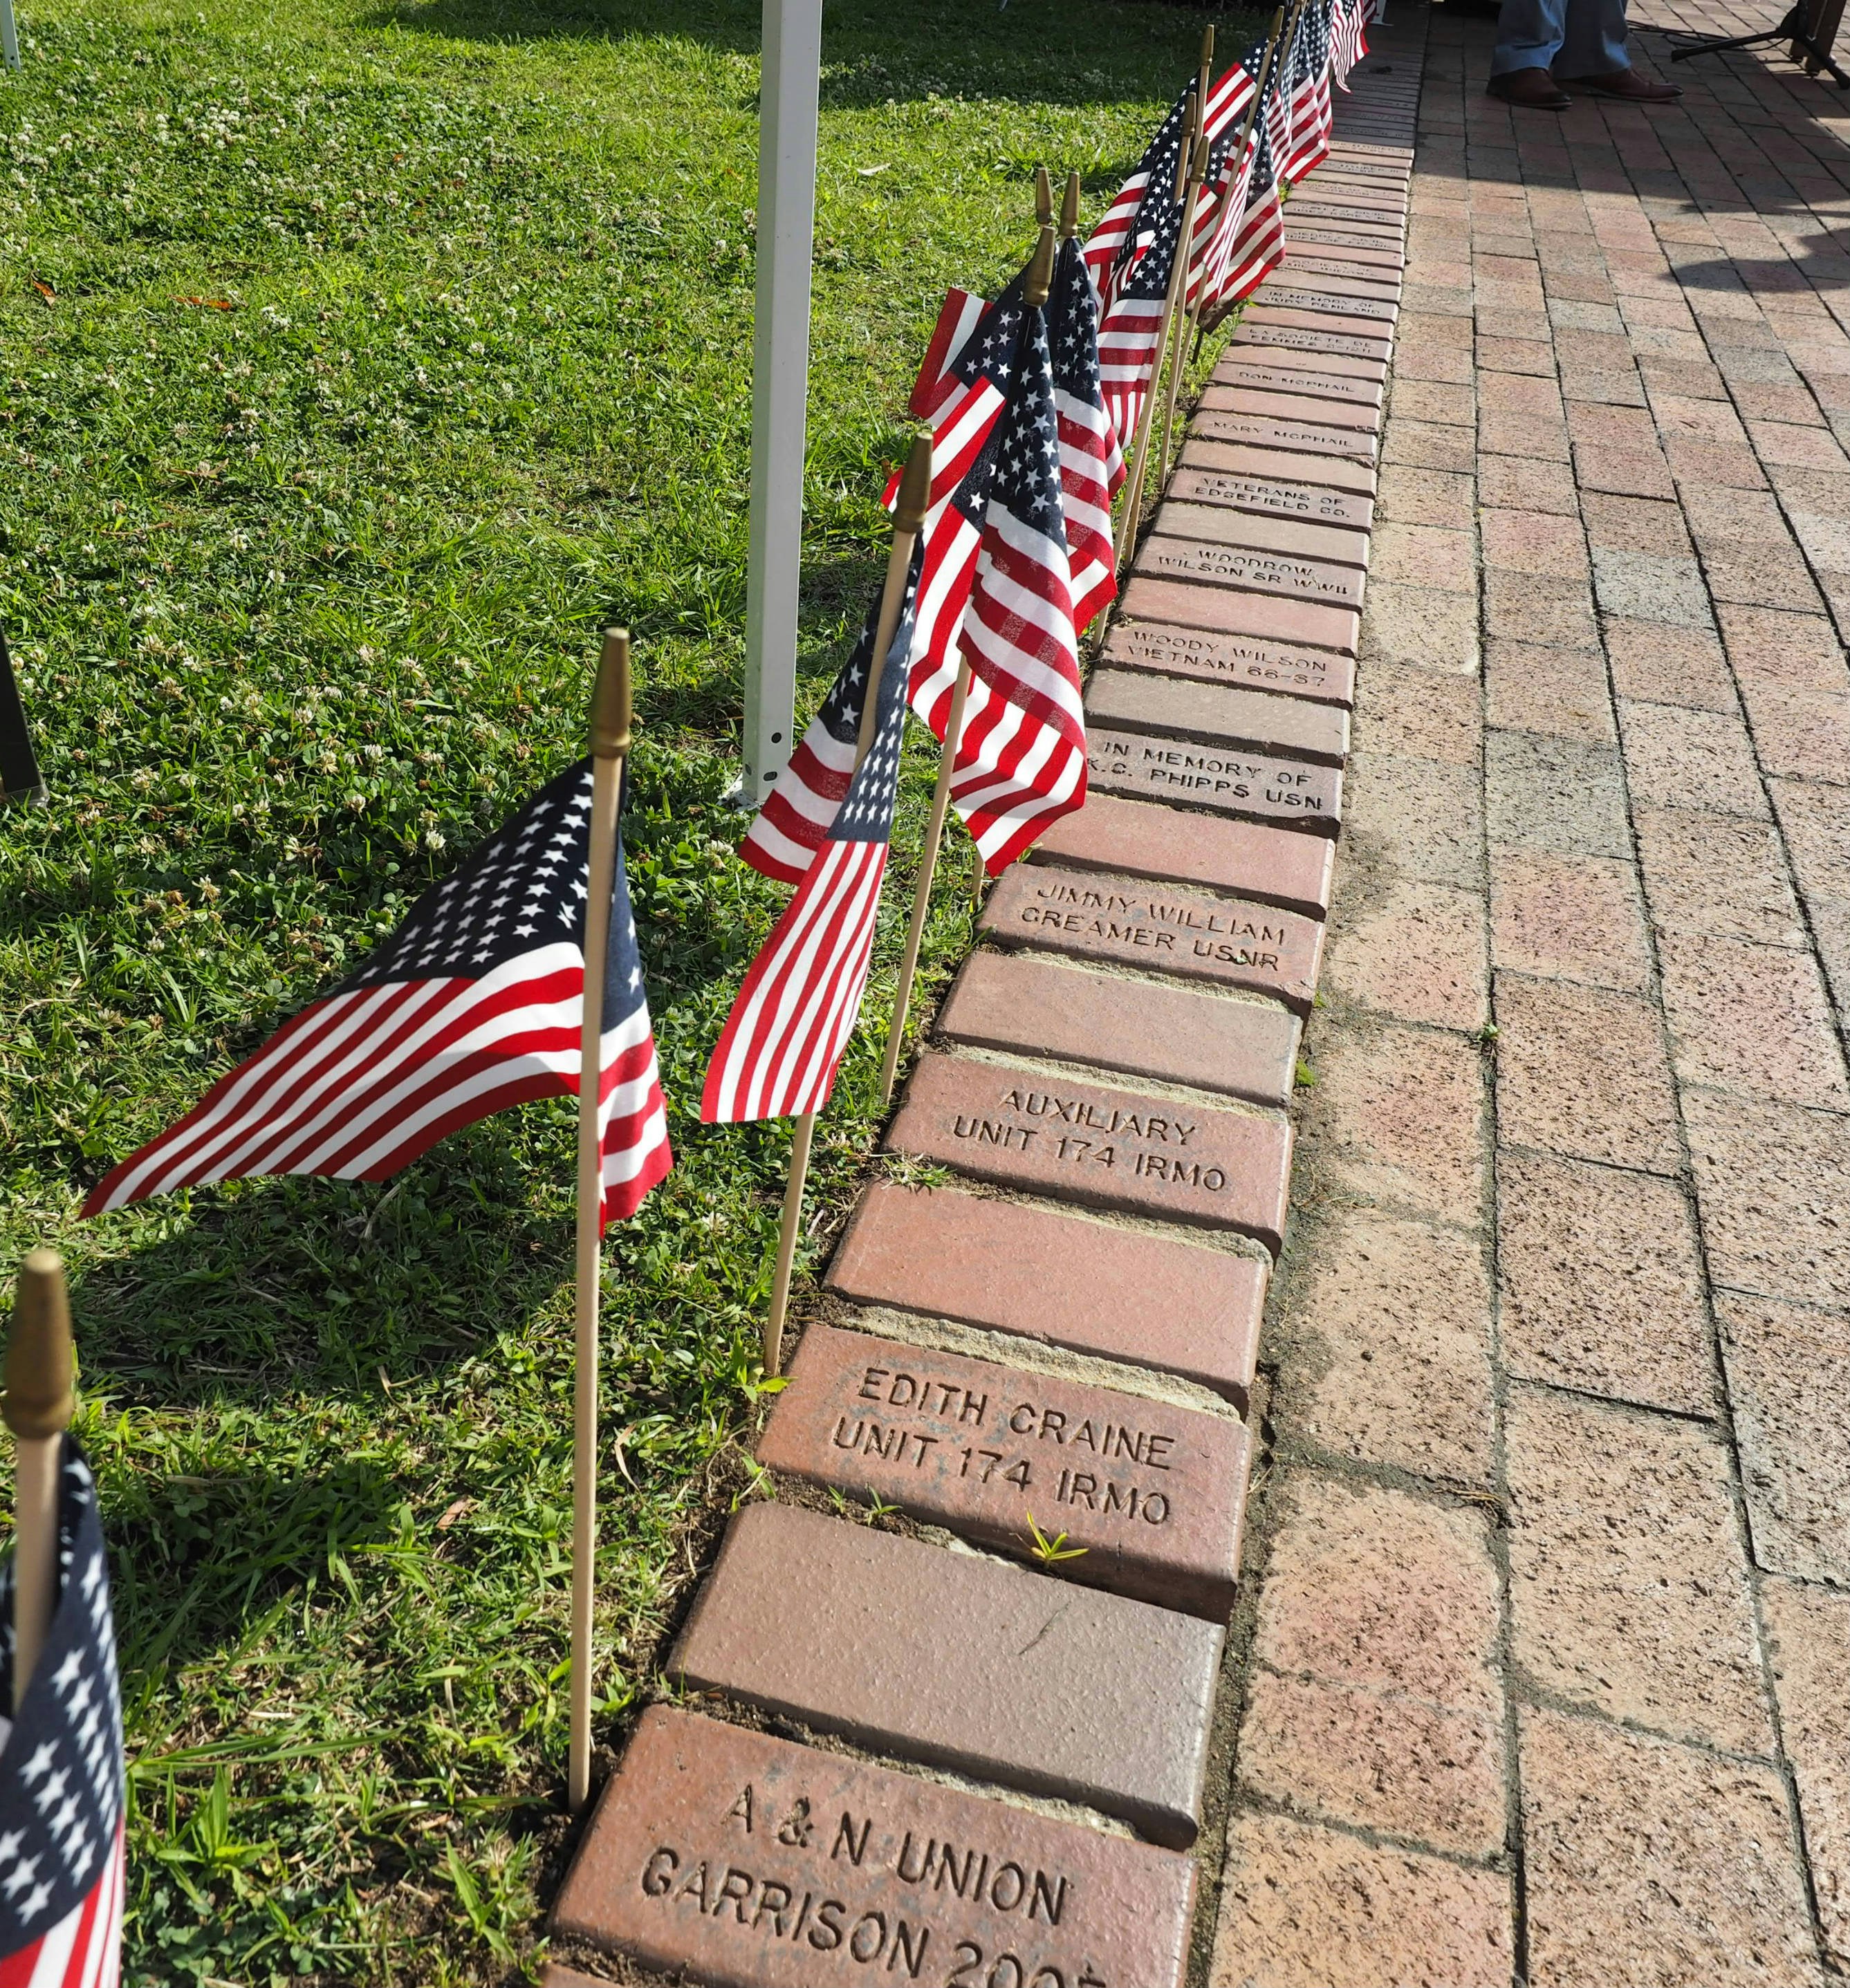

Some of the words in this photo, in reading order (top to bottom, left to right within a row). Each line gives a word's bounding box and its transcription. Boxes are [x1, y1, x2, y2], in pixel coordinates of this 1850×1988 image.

[1290, 294, 1350, 305] MEMORY
[1239, 371, 1273, 381] DON
[1282, 378, 1355, 393] MCPHAIL
[1213, 421, 1264, 434] MARY
[1274, 430, 1353, 448] MCPHAIL
[1194, 487, 1309, 510] EDGEFIELD
[1320, 506, 1351, 518] CO.
[1203, 478, 1311, 501] VETERANS
[1320, 496, 1347, 506] OF
[1158, 556, 1243, 577] WILSON
[1252, 571, 1282, 584] SR
[1293, 579, 1348, 595] WWII
[1198, 550, 1314, 577] WOODROW
[1127, 645, 1235, 673] VIETNAM
[1247, 666, 1326, 687] 66-67
[1134, 631, 1219, 653] WOODY
[1232, 647, 1326, 673] WILSON
[1103, 741, 1129, 756] IN
[1143, 748, 1261, 779] MEMORY
[1276, 770, 1313, 787] OF
[1149, 769, 1250, 799] PHIPPS
[1265, 789, 1324, 811] USN
[1037, 884, 1137, 914] JIMMY
[1149, 903, 1285, 947] WILLIAM
[1192, 939, 1279, 972] USNR
[997, 1089, 1196, 1146] AUXILIARY
[952, 1115, 1039, 1151] UNIT
[1055, 1135, 1116, 1169] 174
[1135, 1153, 1225, 1192] IRMO
[858, 1366, 988, 1427] EDITH
[1008, 1401, 1176, 1471] CRAINE
[831, 1415, 939, 1468] UNIT
[959, 1447, 1032, 1493] 174
[1054, 1467, 1171, 1525] IRMO
[721, 1783, 753, 1834] A
[777, 1796, 814, 1849] &
[831, 1810, 872, 1867] N
[896, 1831, 1068, 1926] UNION
[641, 1846, 930, 1979] GARRISON
